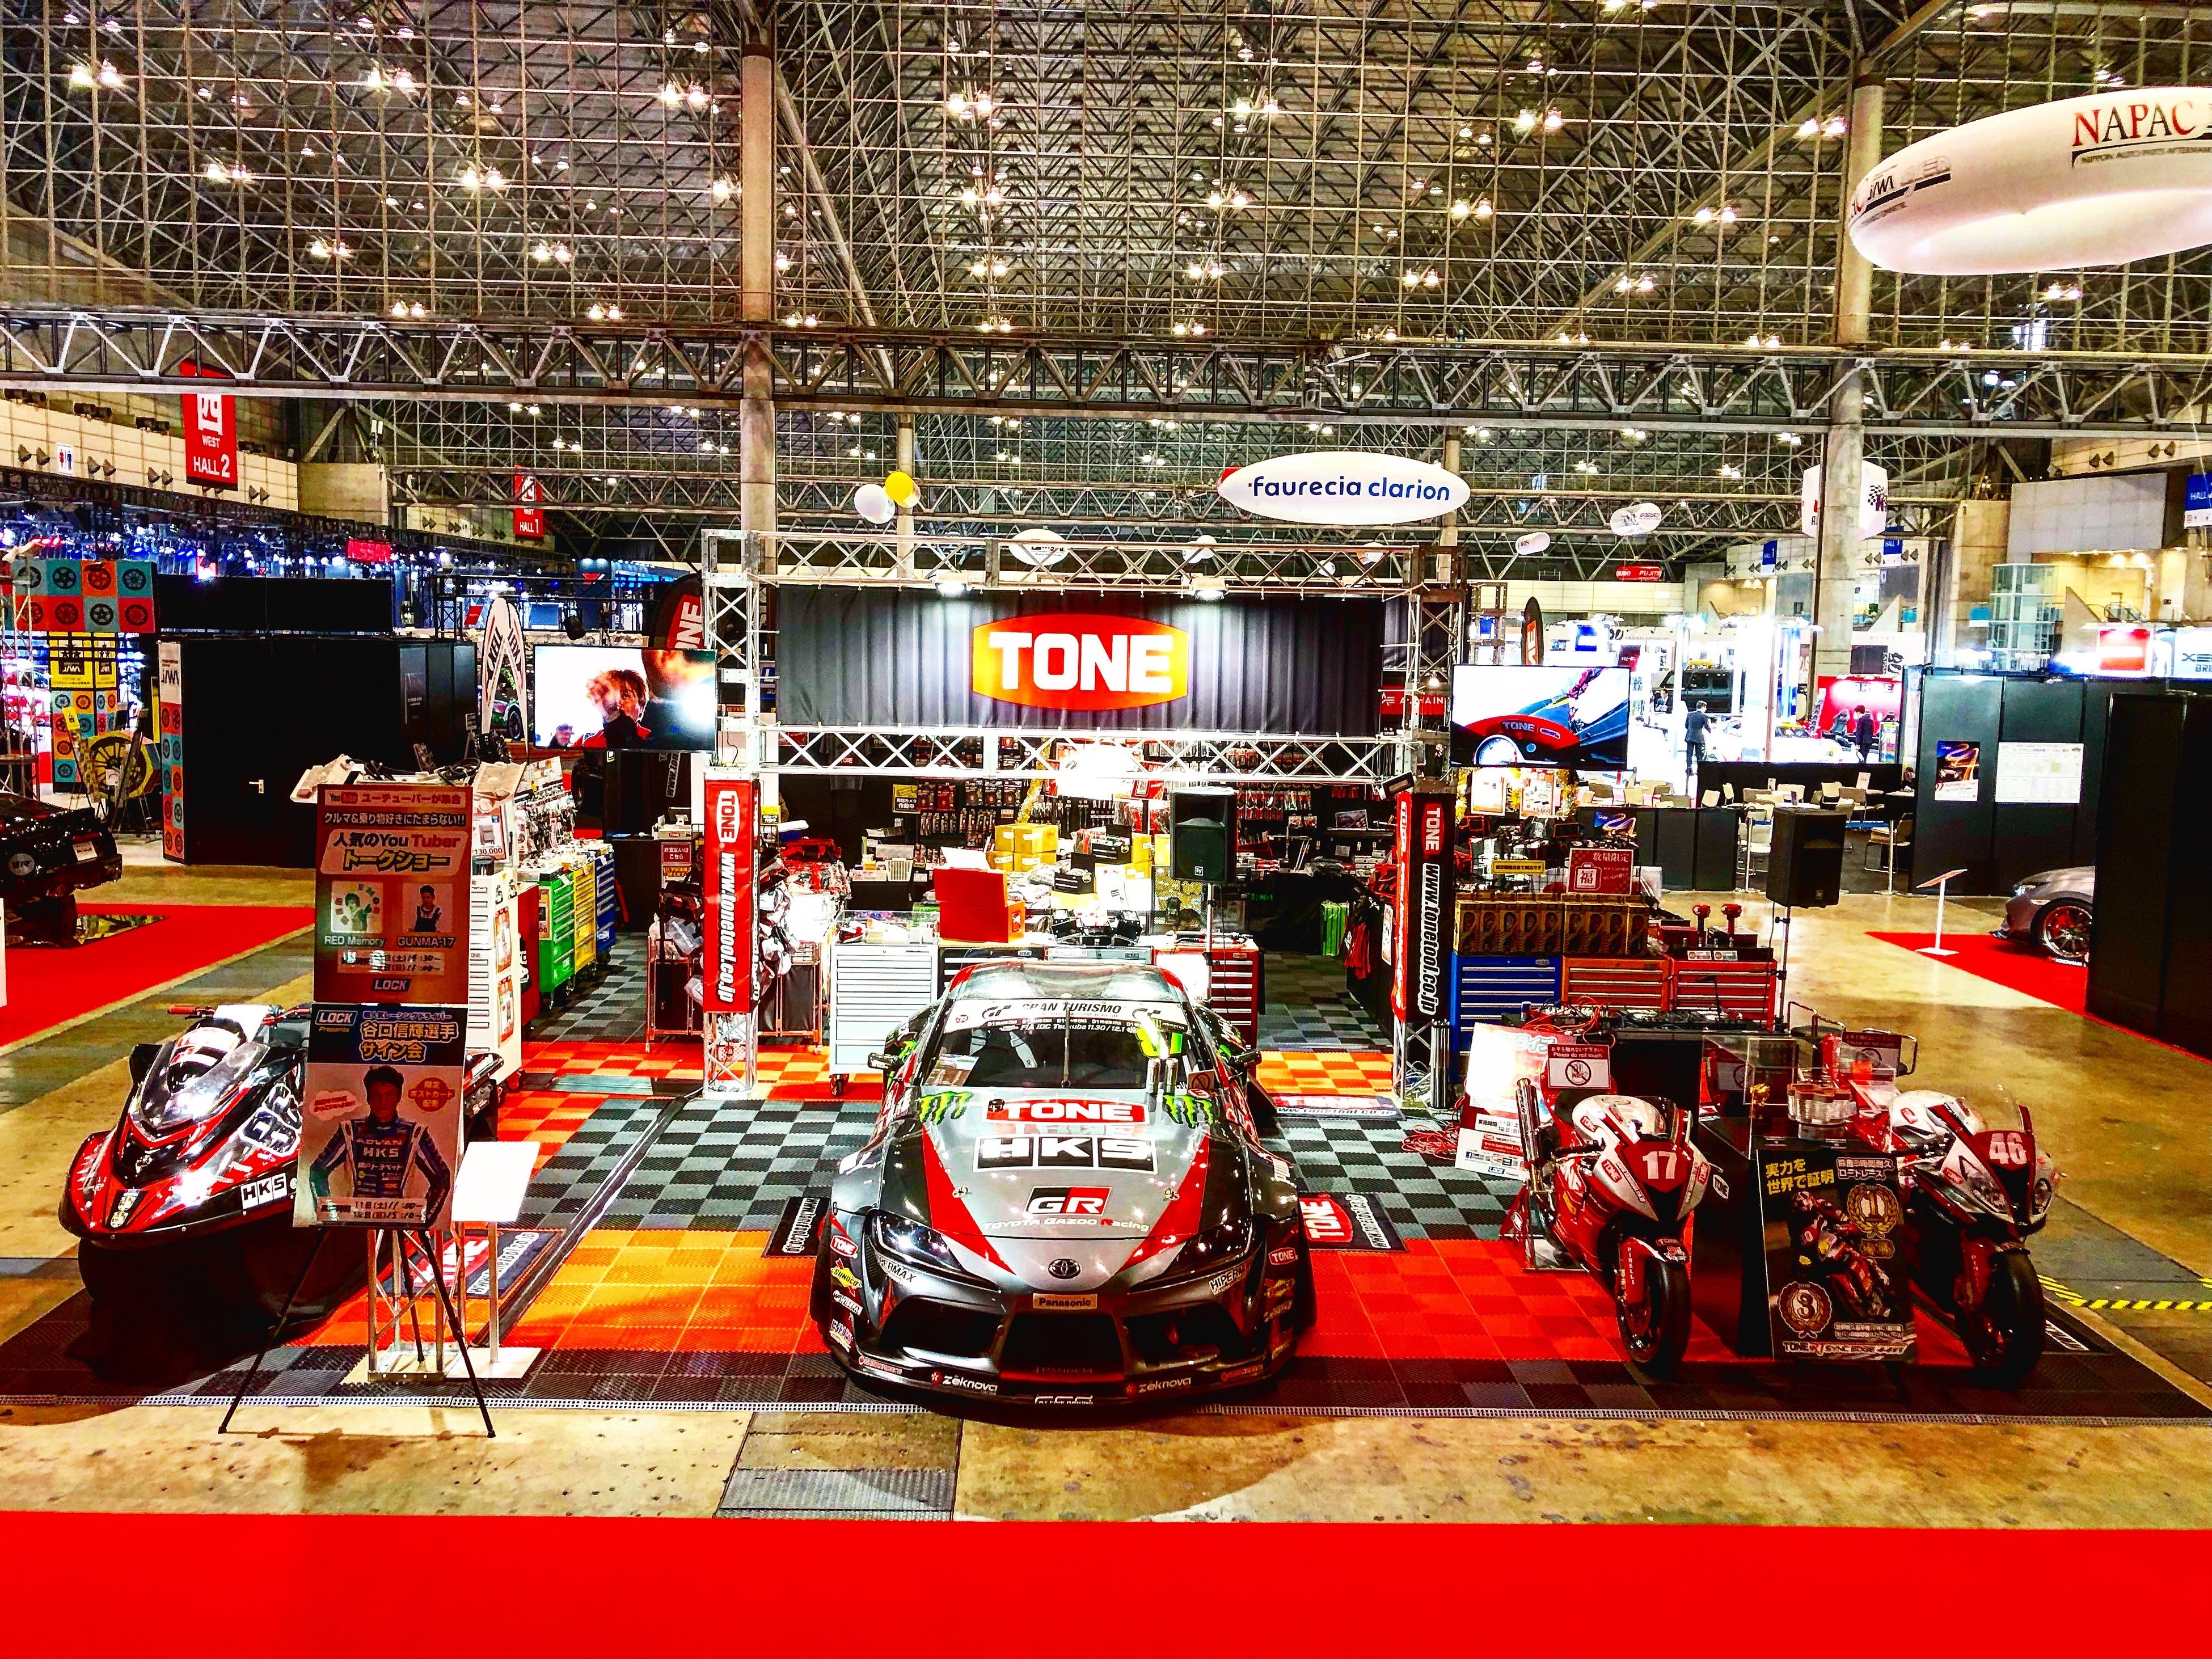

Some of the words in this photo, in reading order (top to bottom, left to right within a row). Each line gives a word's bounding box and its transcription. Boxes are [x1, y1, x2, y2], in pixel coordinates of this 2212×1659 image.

[2072, 100, 2198, 147] NAPAC
[202, 434, 221, 448] WEST
[193, 455, 220, 476] HALL
[221, 453, 230, 478] 2
[1253, 476, 1361, 497] faurecia
[1368, 477, 1450, 501] clarion
[519, 520, 534, 533] HALL
[535, 518, 539, 534] 1
[989, 631, 1174, 694] TONE
[1502, 721, 1535, 732] TONE
[721, 795, 736, 839] TONE
[1425, 807, 1441, 851] TONE
[343, 849, 451, 871] トークショー
[1593, 852, 1629, 862] 数量限定
[719, 852, 736, 1002] www.tonetool.co.jp
[324, 936, 345, 945] RED
[398, 937, 456, 947] GUNMA-17
[1421, 864, 1440, 1014] www.tonetool.co.jp
[374, 979, 408, 991] LOCK
[319, 1012, 353, 1024] LOCK
[1063, 1002, 1122, 1014] TURISMO
[362, 1022, 455, 1040] 谷口信輝選手
[361, 1042, 423, 1059] サイン会
[1003, 1101, 1134, 1121] TONE
[363, 1147, 399, 1157] HKS
[981, 1137, 1151, 1163] HKS
[1989, 1132, 2027, 1165] 46
[1603, 1160, 1622, 1183] TONE
[1642, 1150, 1678, 1180] 17
[1698, 1162, 1709, 1184] TONE
[1766, 1159, 1806, 1179] 実力を
[243, 1176, 285, 1201] HKS
[1714, 1176, 1729, 1198] TONE
[1766, 1169, 1835, 1195] 世界で証明
[1028, 1196, 1105, 1215] GR
[982, 1219, 1041, 1231] TOYOTA
[1100, 1218, 1150, 1232] Racing
[1299, 1200, 1345, 1239] TONE
[833, 1237, 857, 1256] TONE
[1272, 1249, 1295, 1263] TONE
[833, 1268, 861, 1286] SUNOCO
[1039, 1297, 1092, 1308] Panasonic
[1796, 1293, 1816, 1319] 3
[1783, 1341, 1809, 1352] TONE
